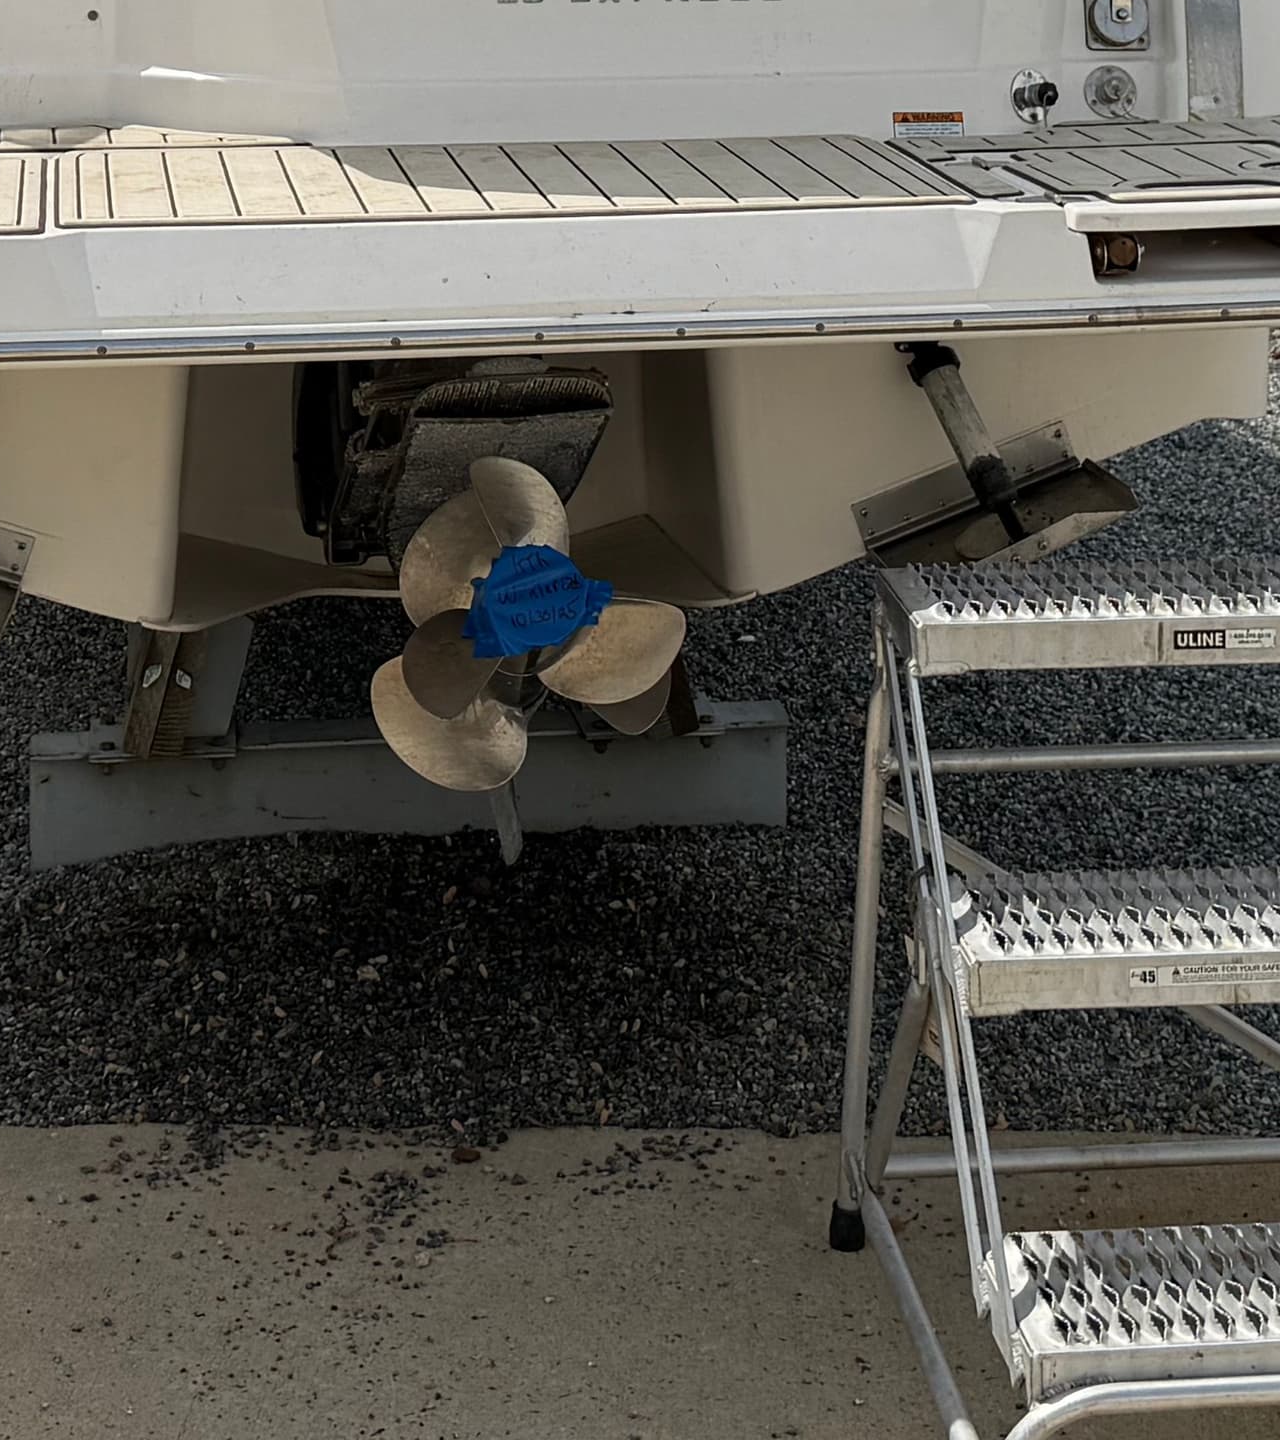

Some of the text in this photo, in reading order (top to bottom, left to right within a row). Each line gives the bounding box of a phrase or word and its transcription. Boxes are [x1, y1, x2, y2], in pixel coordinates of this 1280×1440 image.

[1177, 632, 1224, 647] ULINE
[1183, 966, 1218, 974] CAUTION
[1222, 965, 1237, 973] FOR
[1239, 964, 1261, 972] YOUR
